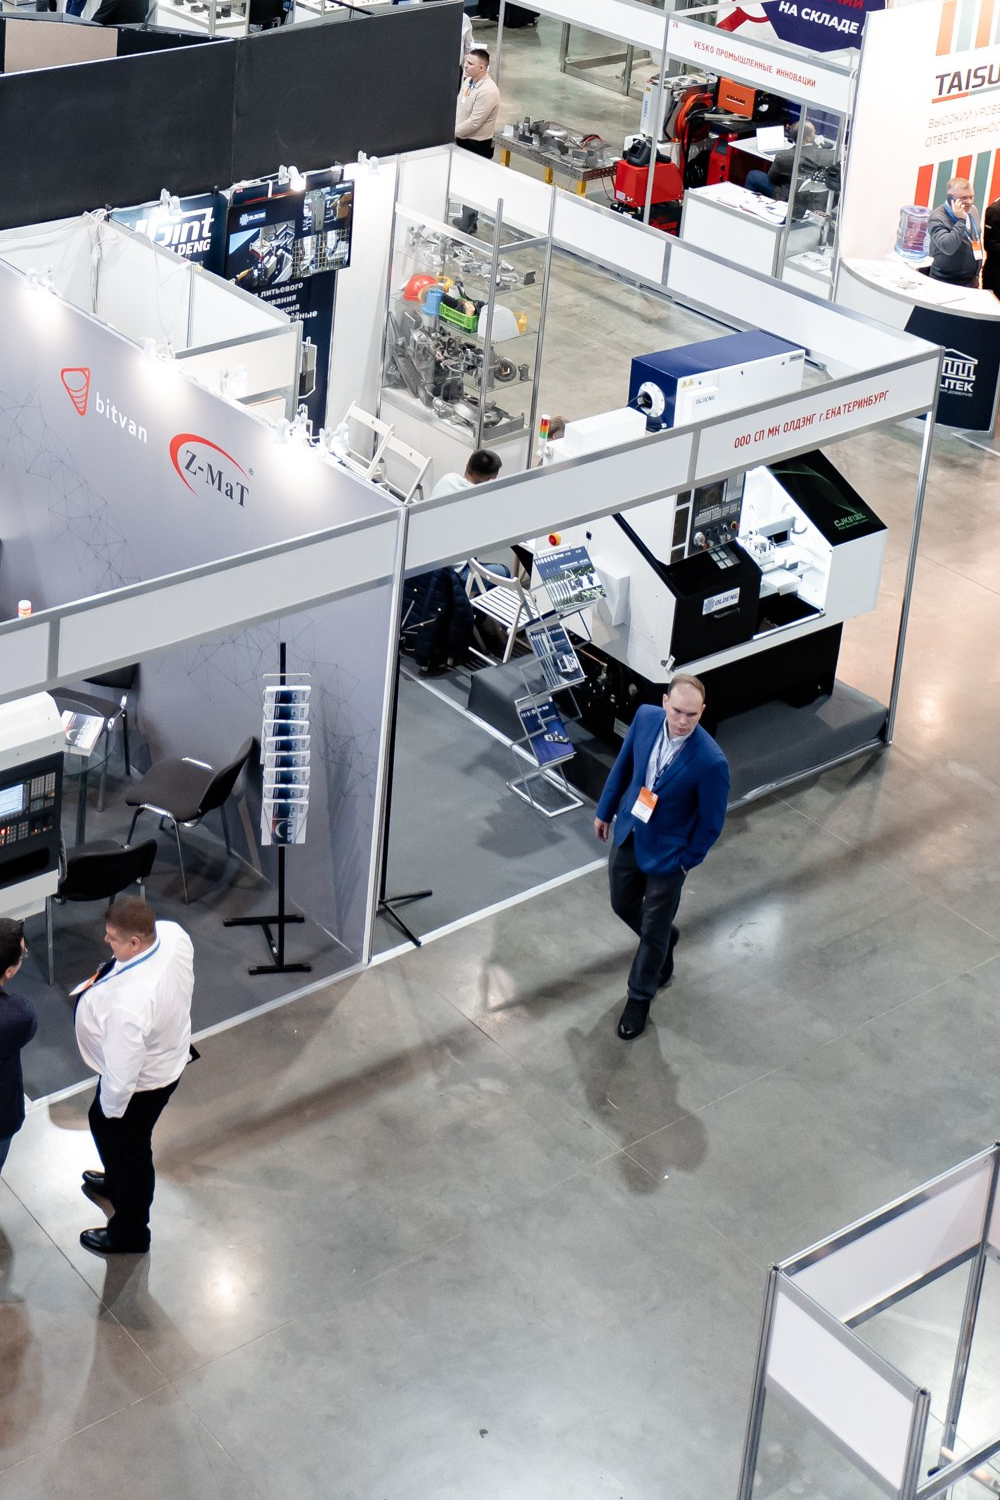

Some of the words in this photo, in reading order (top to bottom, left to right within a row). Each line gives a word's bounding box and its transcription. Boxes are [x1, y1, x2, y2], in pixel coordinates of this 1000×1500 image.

[778, 1, 798, 18] НА
[801, 7, 860, 35] СКЛАДЕ
[693, 39, 715, 55] VESKO
[716, 48, 774, 75] ПРОМЫШЛЕННЫЕ
[776, 68, 817, 88] ИННОВАЦИИ
[166, 239, 211, 255] LDENG
[260, 282, 304, 298] литьевого
[95, 391, 148, 444] bitvan
[734, 434, 752, 449] ООО
[754, 429, 765, 442] СП
[783, 413, 817, 434] ОЛДЭНГ
[184, 449, 250, 508] Z-MaT
